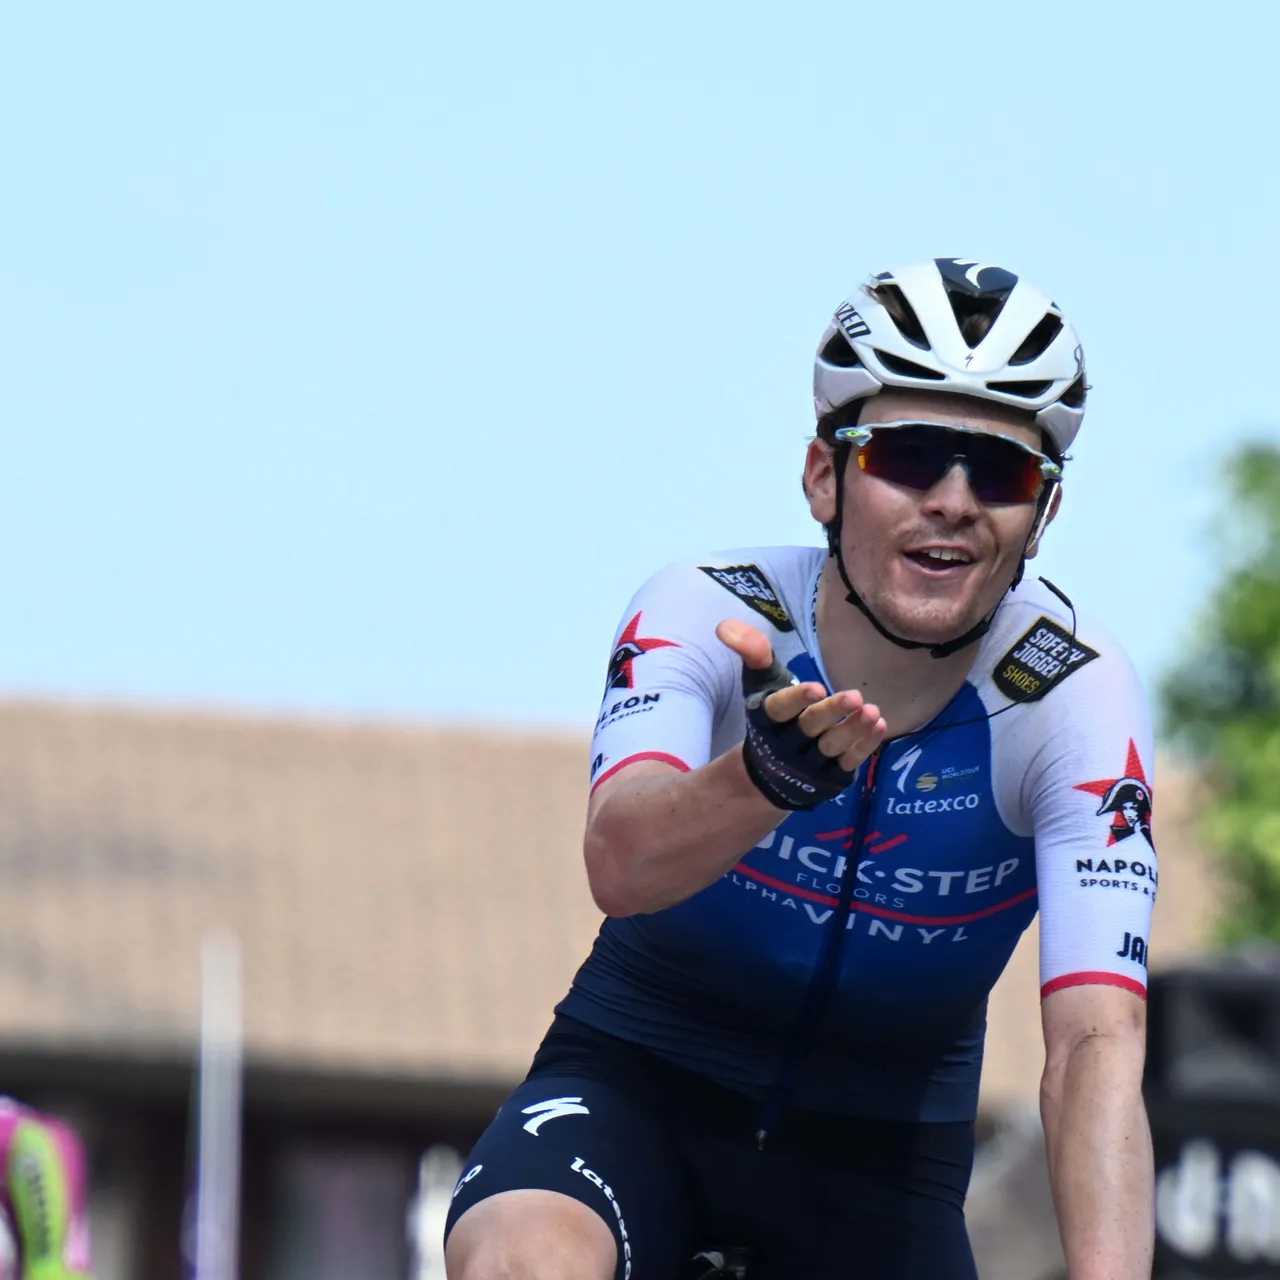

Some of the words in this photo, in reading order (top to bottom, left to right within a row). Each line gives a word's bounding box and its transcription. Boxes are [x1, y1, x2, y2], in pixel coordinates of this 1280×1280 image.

[1029, 627, 1086, 665] SAFETY
[1002, 665, 1040, 694] SHOES
[886, 793, 979, 815] latexco
[1076, 859, 1158, 886] NAPOL
[1080, 879, 1138, 891] SPORTS
